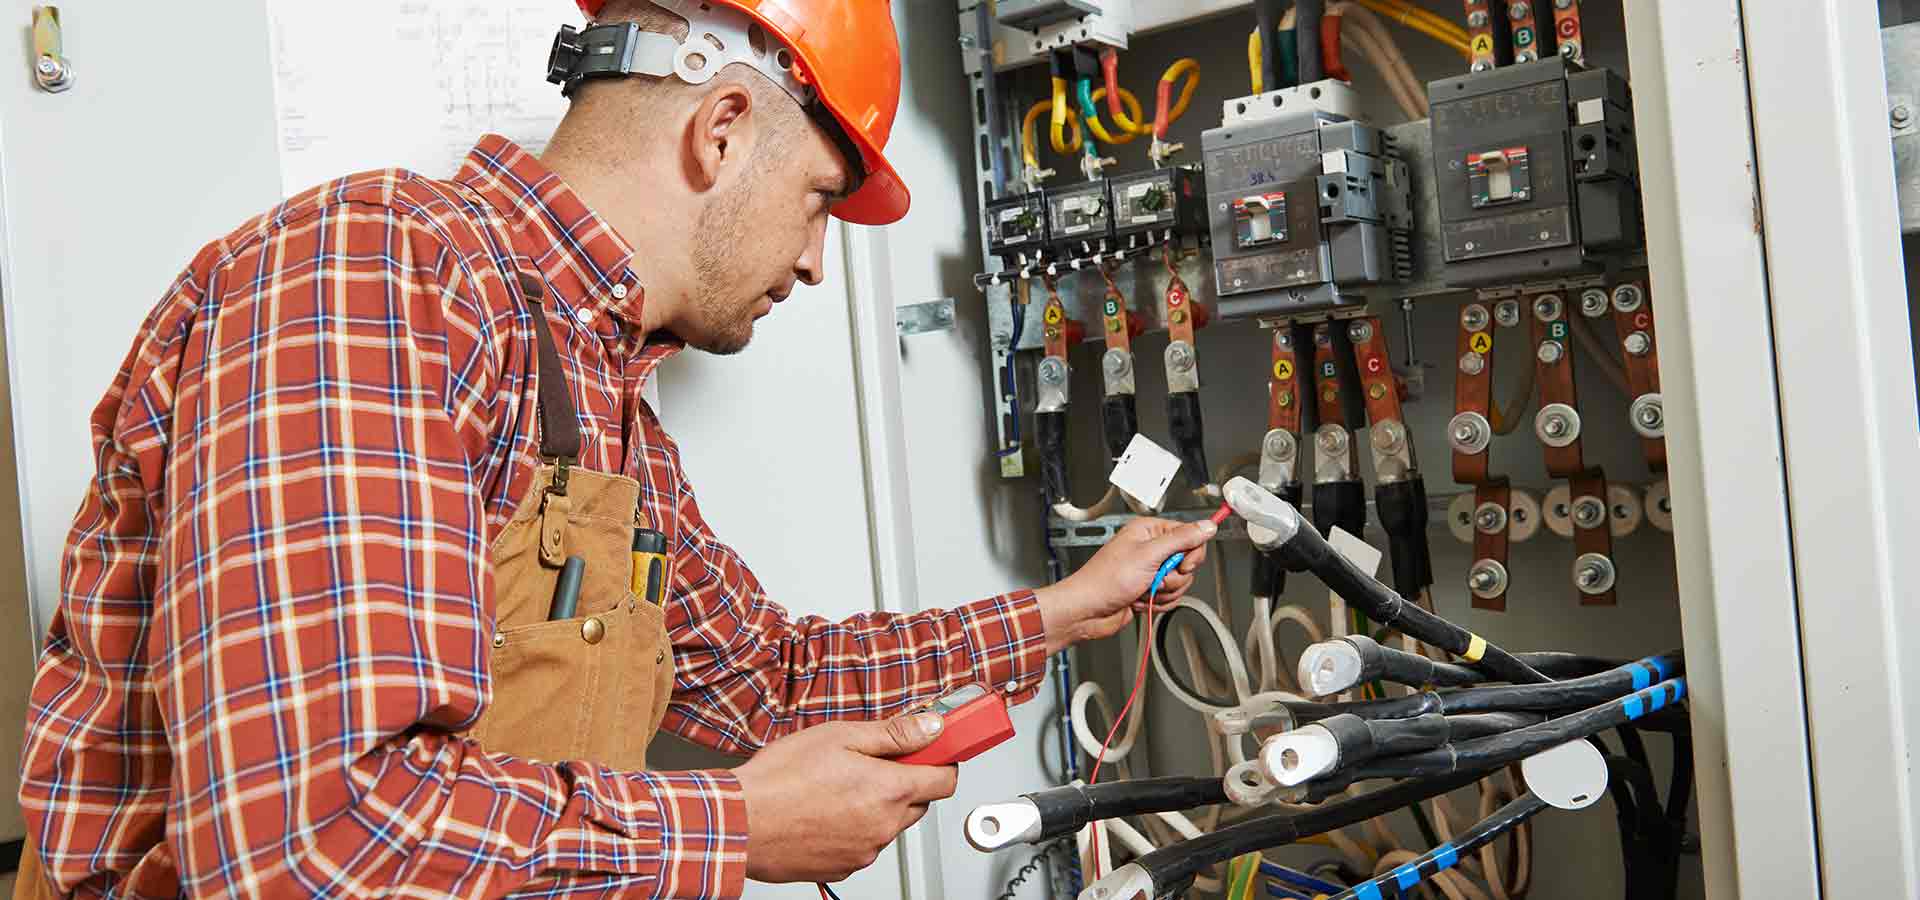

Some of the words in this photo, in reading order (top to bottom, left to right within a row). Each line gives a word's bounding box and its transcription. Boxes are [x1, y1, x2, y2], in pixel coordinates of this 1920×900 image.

[1561, 22, 1574, 35] C
[1477, 36, 1489, 50] A
[1518, 30, 1530, 44] B
[1170, 290, 1182, 304] C
[1048, 309, 1058, 320] A
[1105, 302, 1117, 314] B
[1635, 313, 1648, 328] C
[1552, 323, 1565, 337] B
[1474, 336, 1487, 349] A
[1279, 363, 1290, 375] A
[1324, 362, 1336, 376] B
[1367, 358, 1380, 372] C
